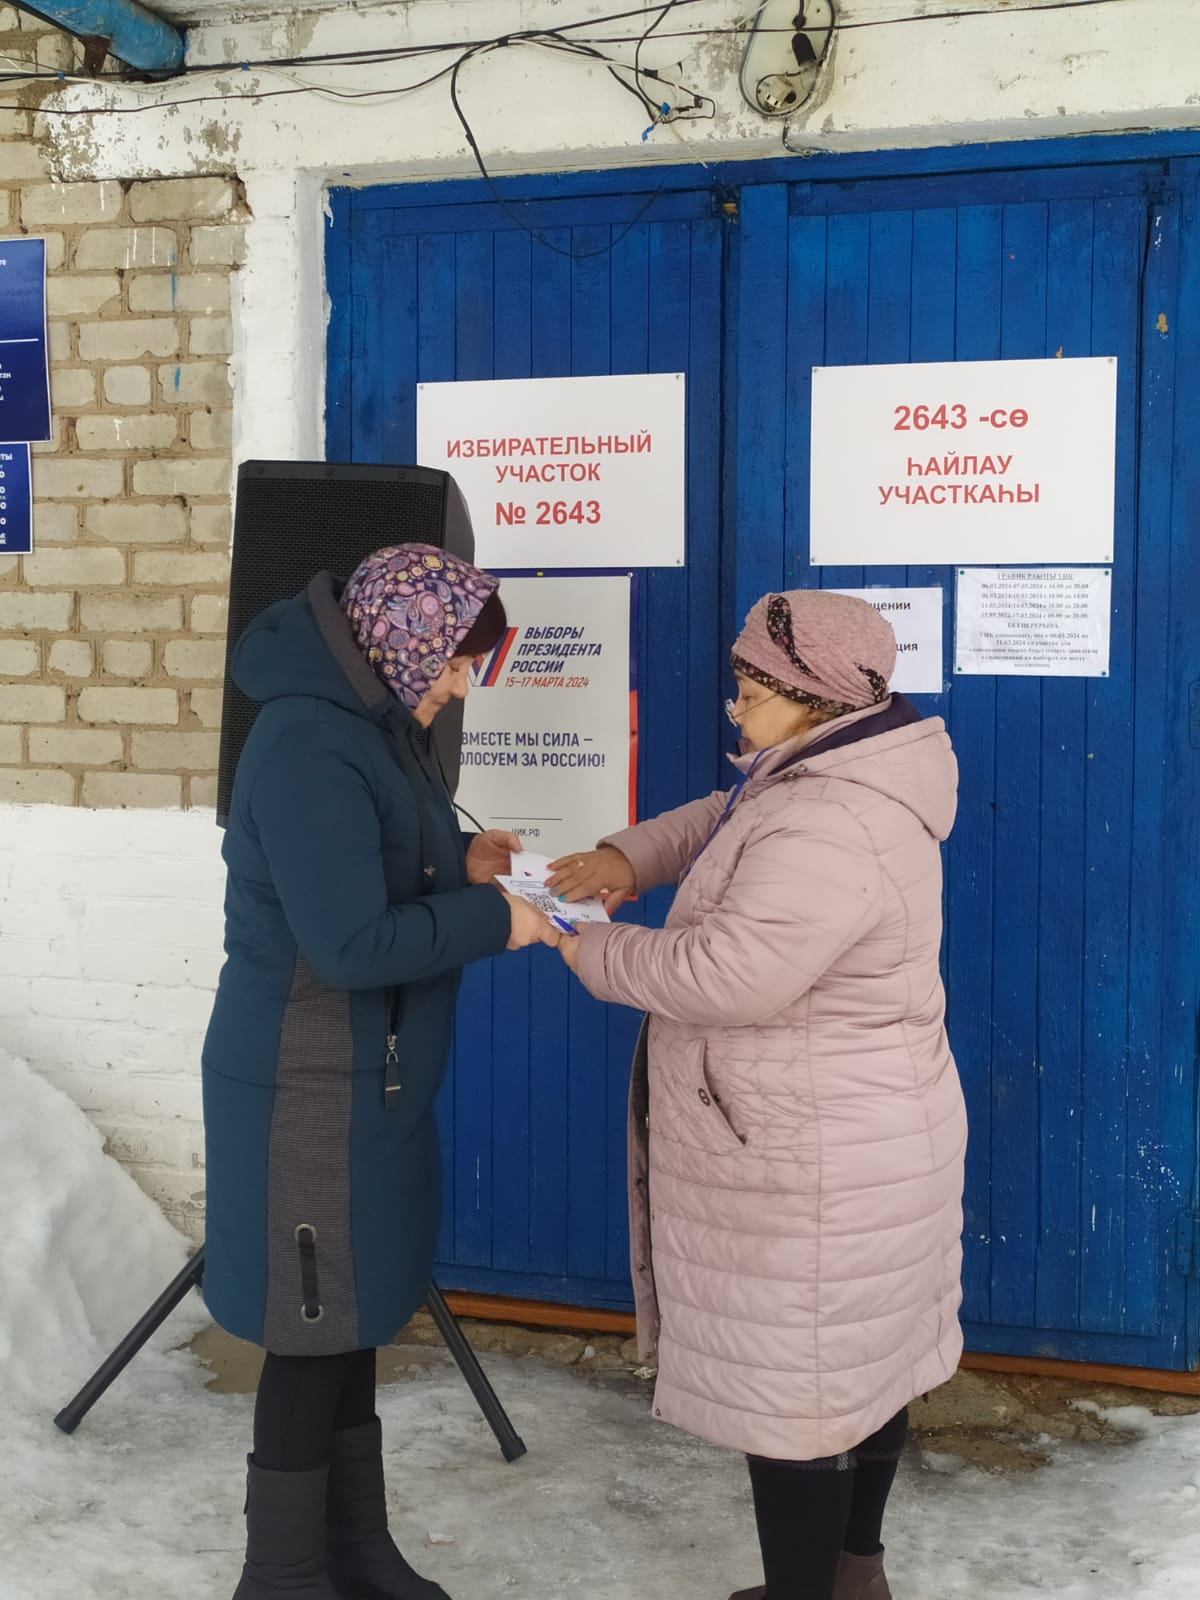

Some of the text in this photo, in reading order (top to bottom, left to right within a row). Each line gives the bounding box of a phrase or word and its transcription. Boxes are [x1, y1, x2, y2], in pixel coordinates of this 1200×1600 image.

[894, 403, 1029, 431] 2643 -сө
[447, 428, 652, 458] ИЗБИРАТЕЛЬНЫЙ
[495, 462, 601, 484] УЧАСТОК
[495, 500, 601, 526] № 2643
[524, 626, 584, 639] ВЫБОРЫ
[517, 643, 602, 658] ПРЕЗИДЕНТА
[510, 660, 564, 673] РОССИИ
[532, 676, 564, 688] МАРТА
[565, 676, 590, 688] 2024
[461, 731, 511, 746] ВМЕСТЕ
[515, 732, 539, 746] МЫ
[542, 732, 580, 747] СИЛА
[459, 751, 606, 768] ОЛОСУЕМ ЗА РОССИЮ!
